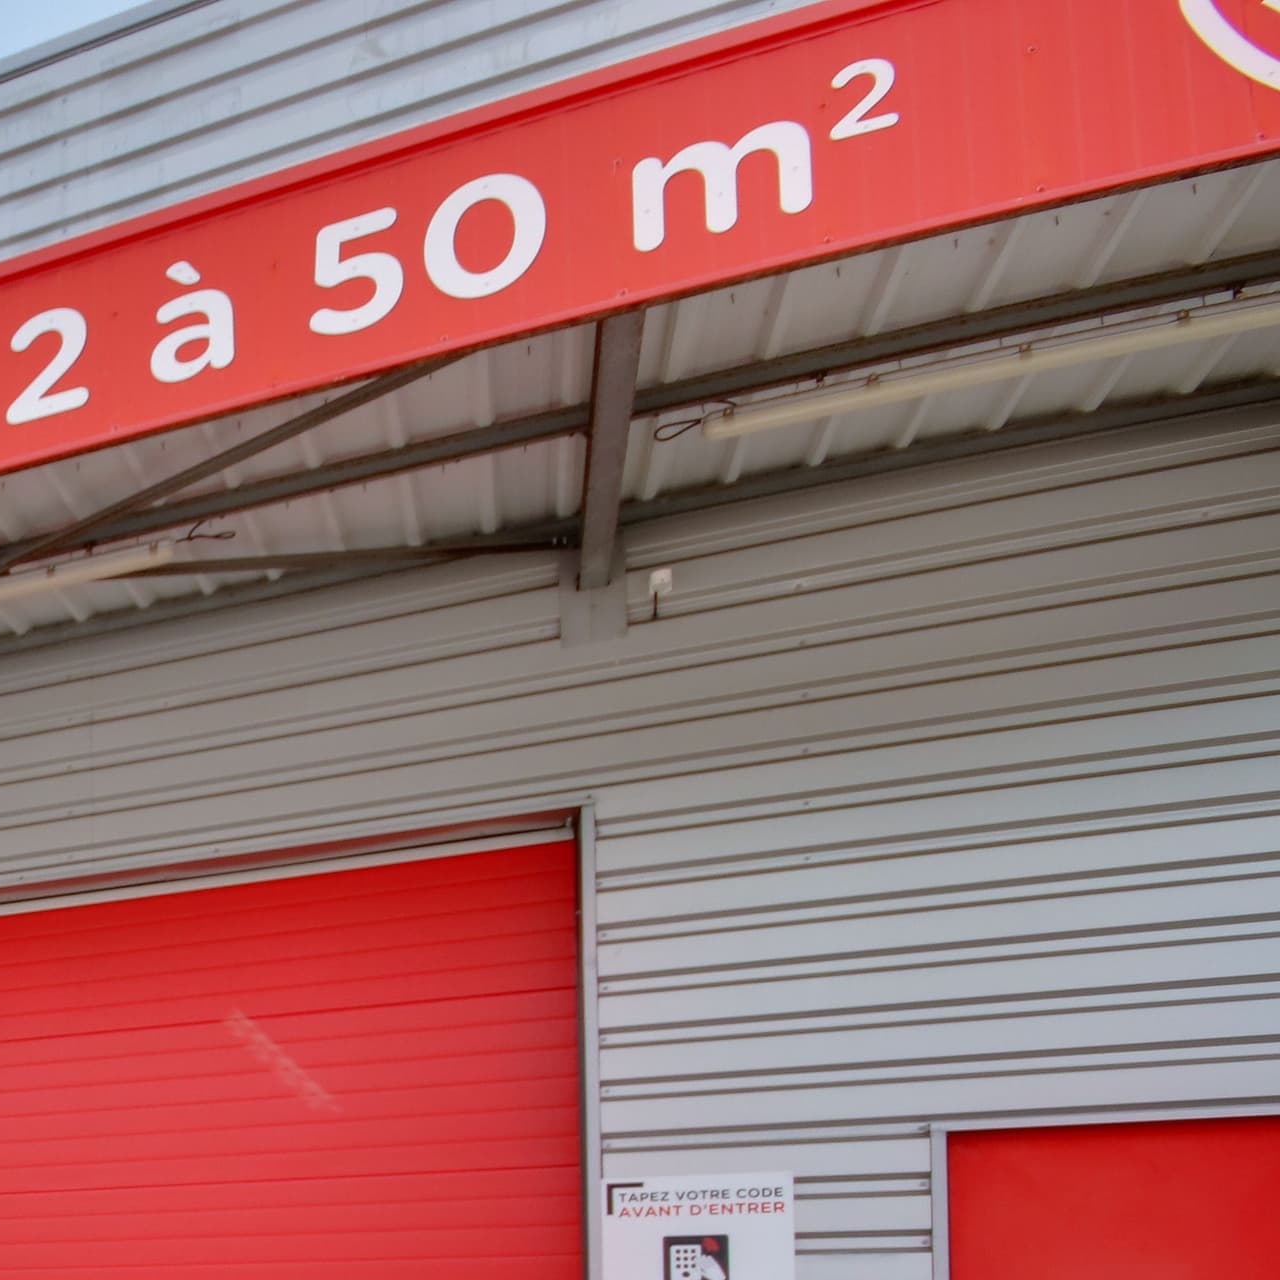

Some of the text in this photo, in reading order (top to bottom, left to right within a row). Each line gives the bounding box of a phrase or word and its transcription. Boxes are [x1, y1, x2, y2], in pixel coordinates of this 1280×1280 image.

[5, 307, 90, 425] 2
[150, 261, 235, 384] à
[309, 172, 547, 336] 50
[618, 1186, 784, 1203] TAPEZ VOTRE CODE
[618, 1201, 786, 1218] AVANT D'ENTRER
